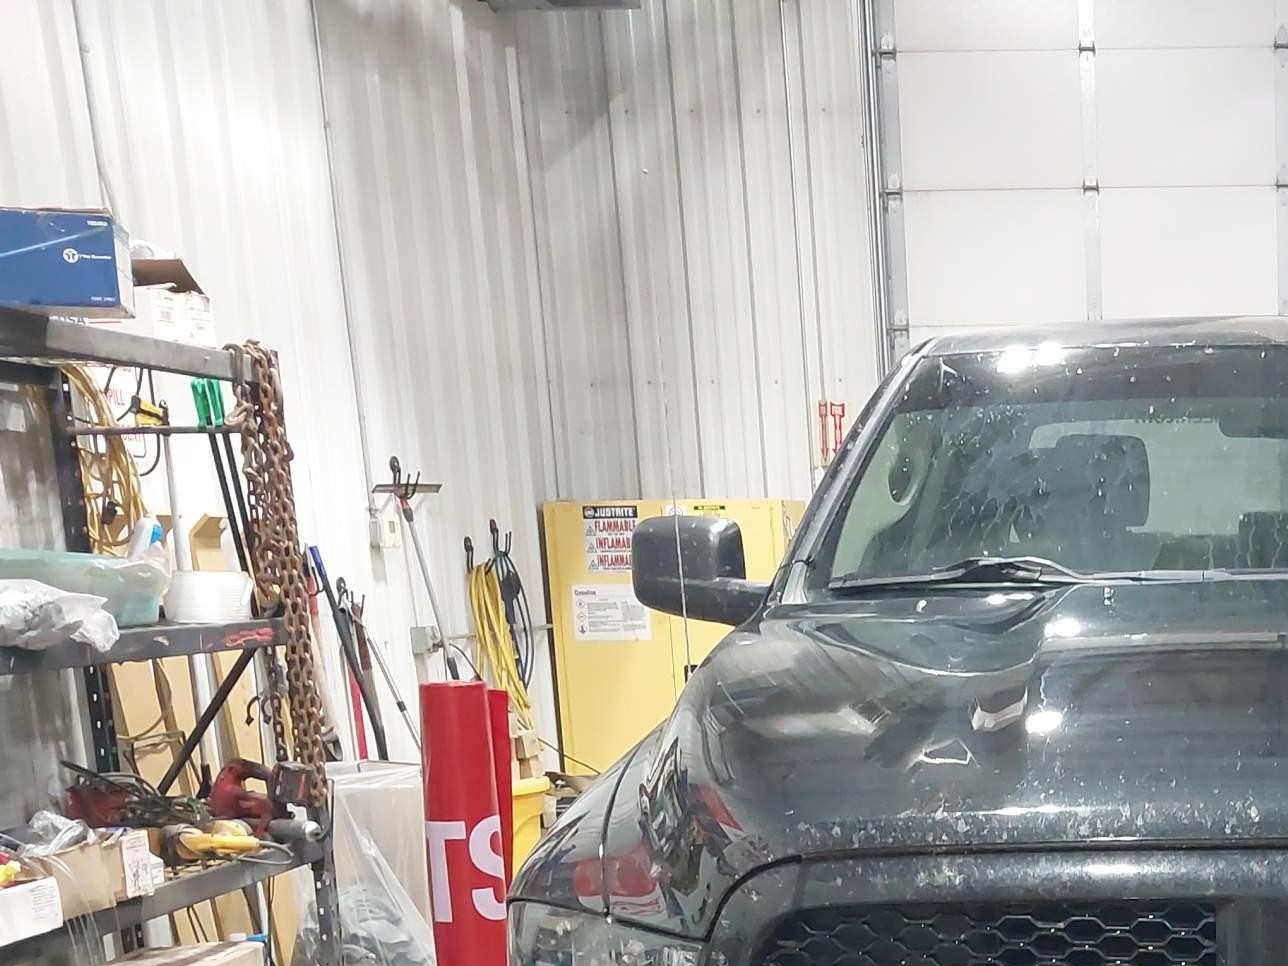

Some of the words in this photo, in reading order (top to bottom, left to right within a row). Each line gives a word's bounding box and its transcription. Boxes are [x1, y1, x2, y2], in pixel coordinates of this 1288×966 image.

[594, 507, 634, 517] JUSTRITE
[595, 536, 632, 549] INFLAMAB
[596, 554, 632, 567] INFLAMMA
